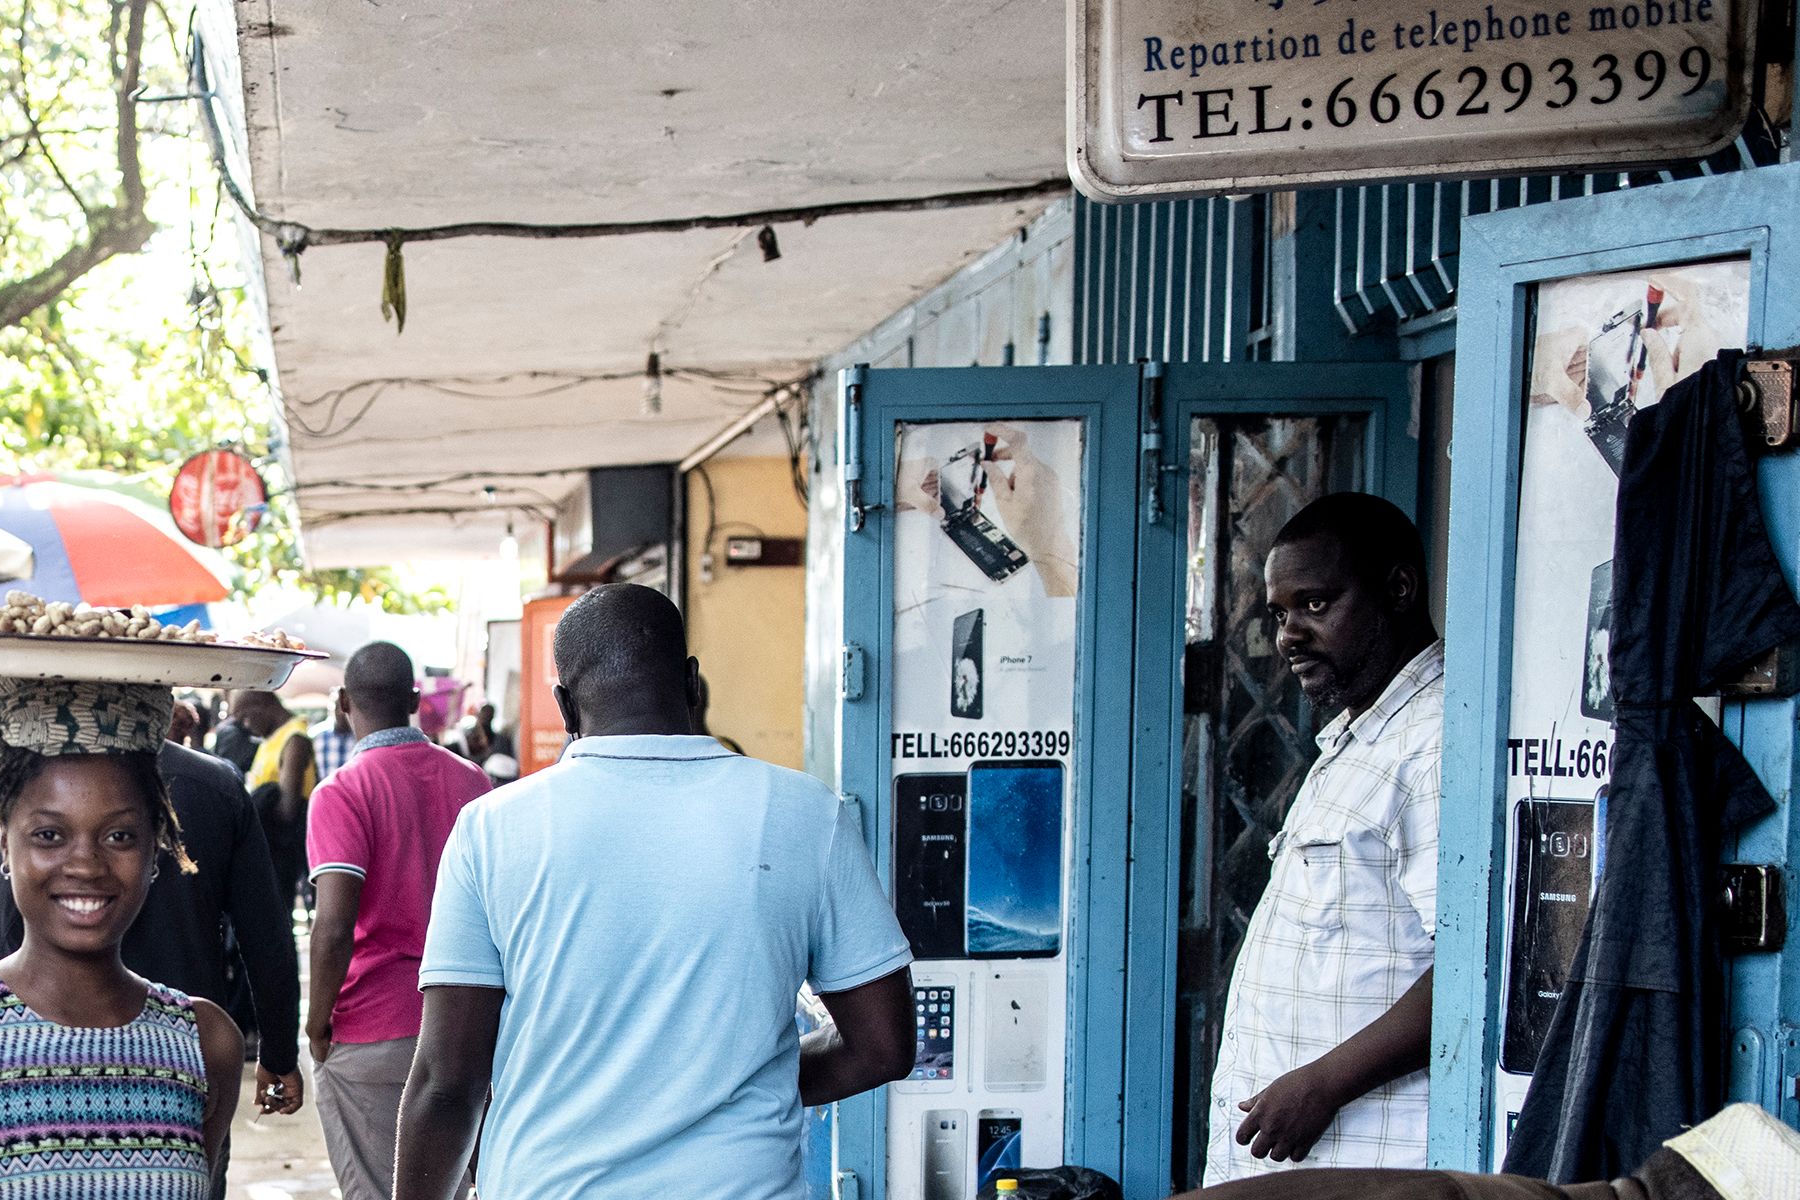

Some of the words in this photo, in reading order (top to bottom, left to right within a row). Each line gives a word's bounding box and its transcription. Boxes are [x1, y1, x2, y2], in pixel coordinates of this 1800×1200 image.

[1144, 29, 1321, 78] Repartion
[1338, 18, 1376, 56] de
[1394, 4, 1571, 53] telephone
[1589, 0, 1714, 33] mobile
[1137, 45, 1713, 144] TEL:666293399
[1000, 655, 1025, 664] iPhone
[1028, 655, 1032, 663] 7
[891, 731, 1070, 759] TELL:666293399
[1508, 738, 1613, 779] TELL:66
[1539, 891, 1577, 903] SAMSUNG
[1538, 990, 1560, 1000] Galaxy
